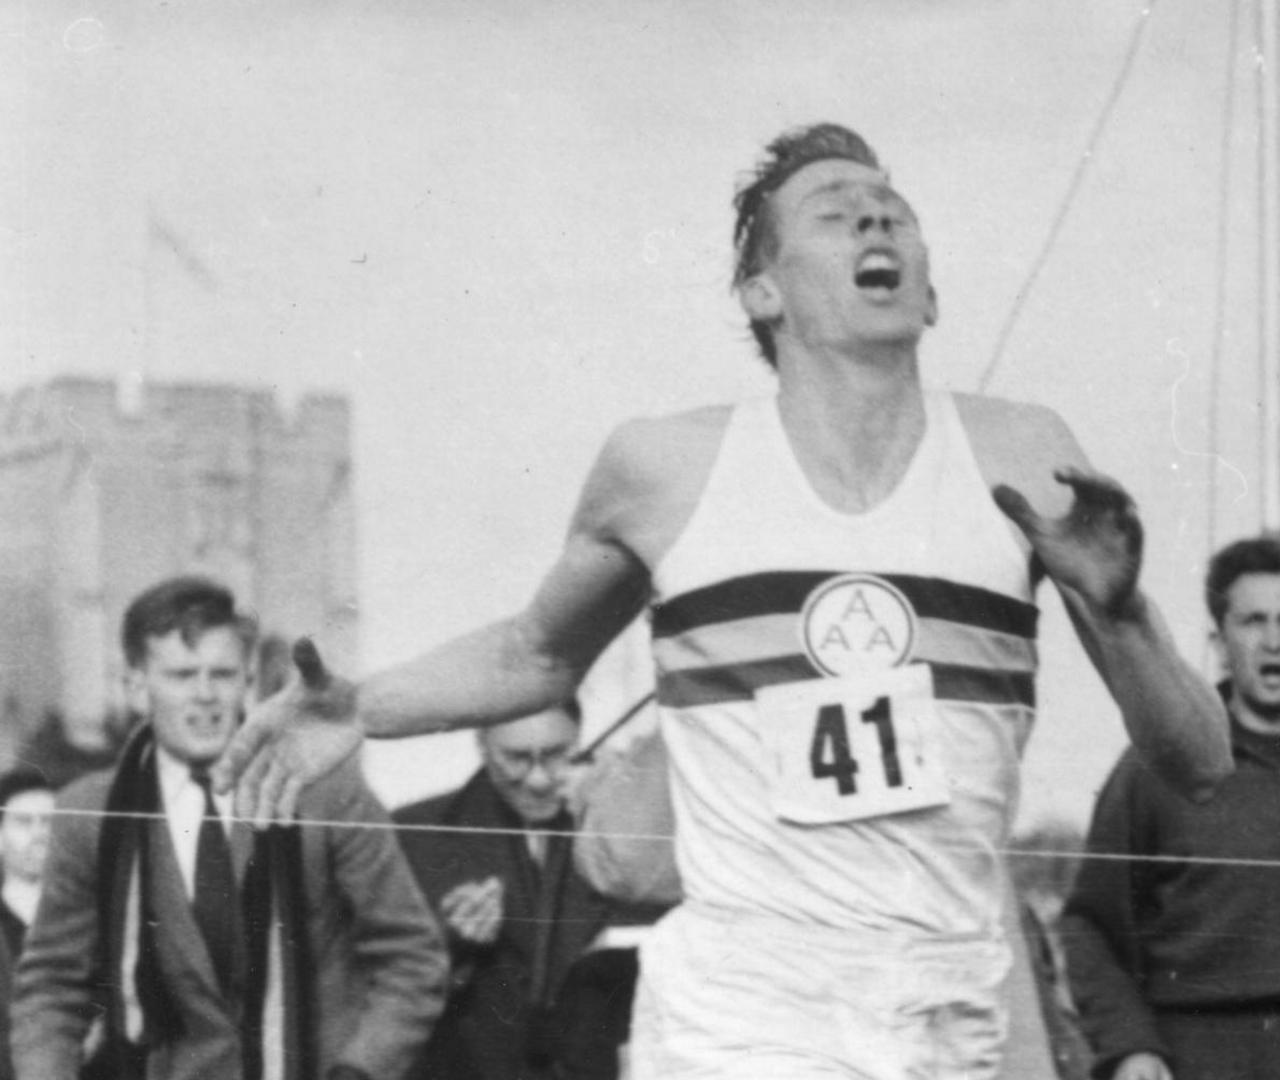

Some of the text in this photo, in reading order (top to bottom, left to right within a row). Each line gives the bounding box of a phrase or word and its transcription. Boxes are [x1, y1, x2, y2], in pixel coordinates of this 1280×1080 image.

[841, 588, 876, 622] A
[819, 624, 897, 652] A A
[810, 695, 904, 796] 41
